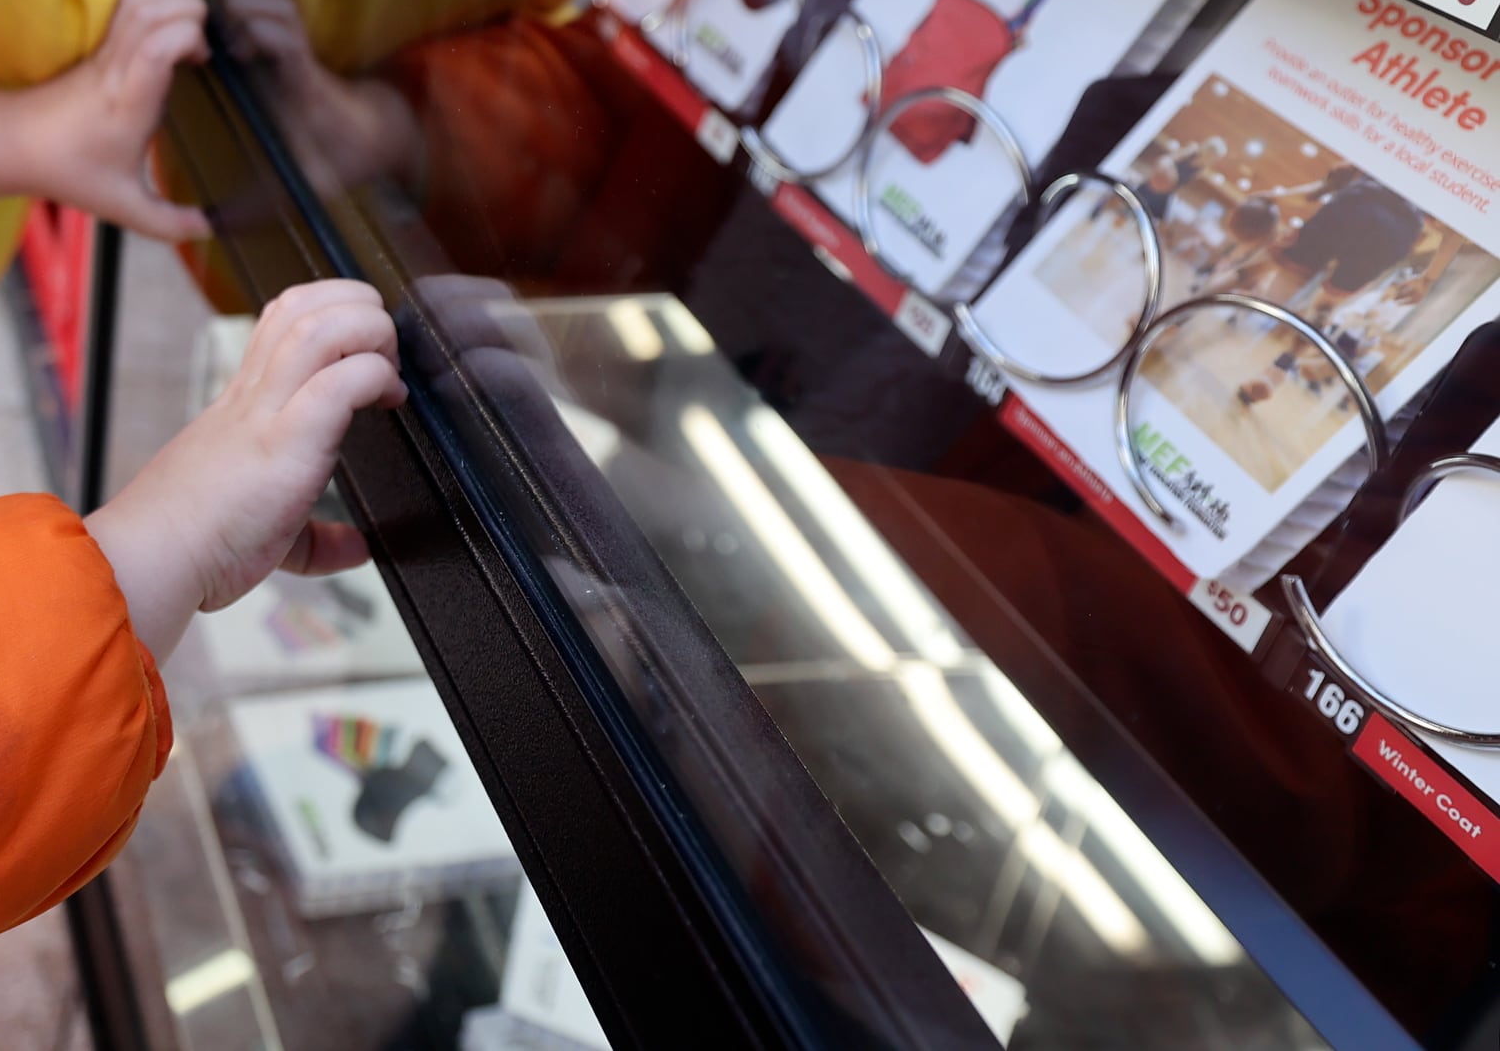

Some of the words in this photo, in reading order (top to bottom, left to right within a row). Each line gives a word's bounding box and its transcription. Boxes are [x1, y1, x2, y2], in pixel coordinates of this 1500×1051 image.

[1350, 40, 1488, 131] Athlete
[1386, 114, 1442, 156] healthy
[1440, 149, 1500, 191] exercise
[1395, 147, 1433, 175] local
[1206, 580, 1248, 628] $50
[1303, 668, 1365, 735] 166
[1378, 738, 1435, 796] Winter
[1435, 793, 1482, 839] Coat
